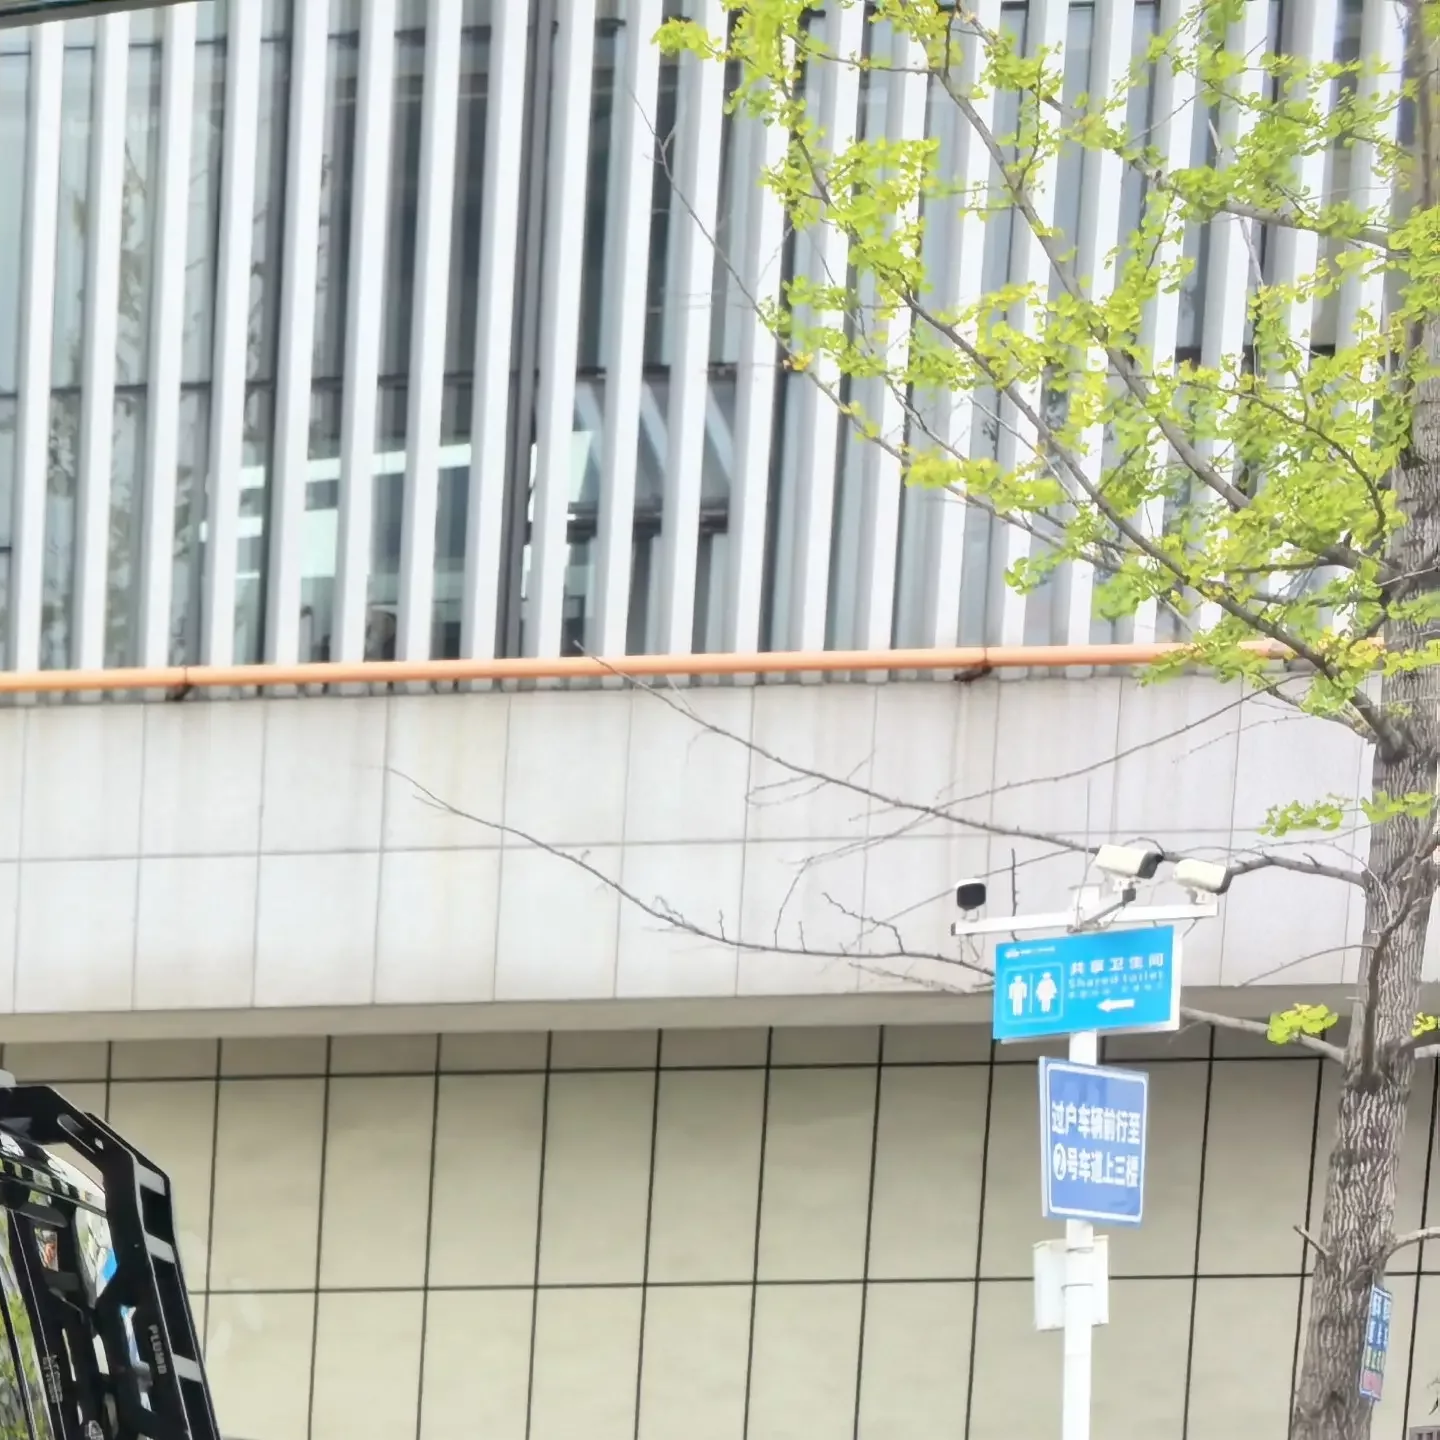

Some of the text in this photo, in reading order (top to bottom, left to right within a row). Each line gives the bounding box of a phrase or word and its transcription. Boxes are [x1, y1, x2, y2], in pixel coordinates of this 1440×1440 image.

[1068, 973, 1119, 989] Shared
[1051, 1100, 1141, 1145] 过户车辆前行至
